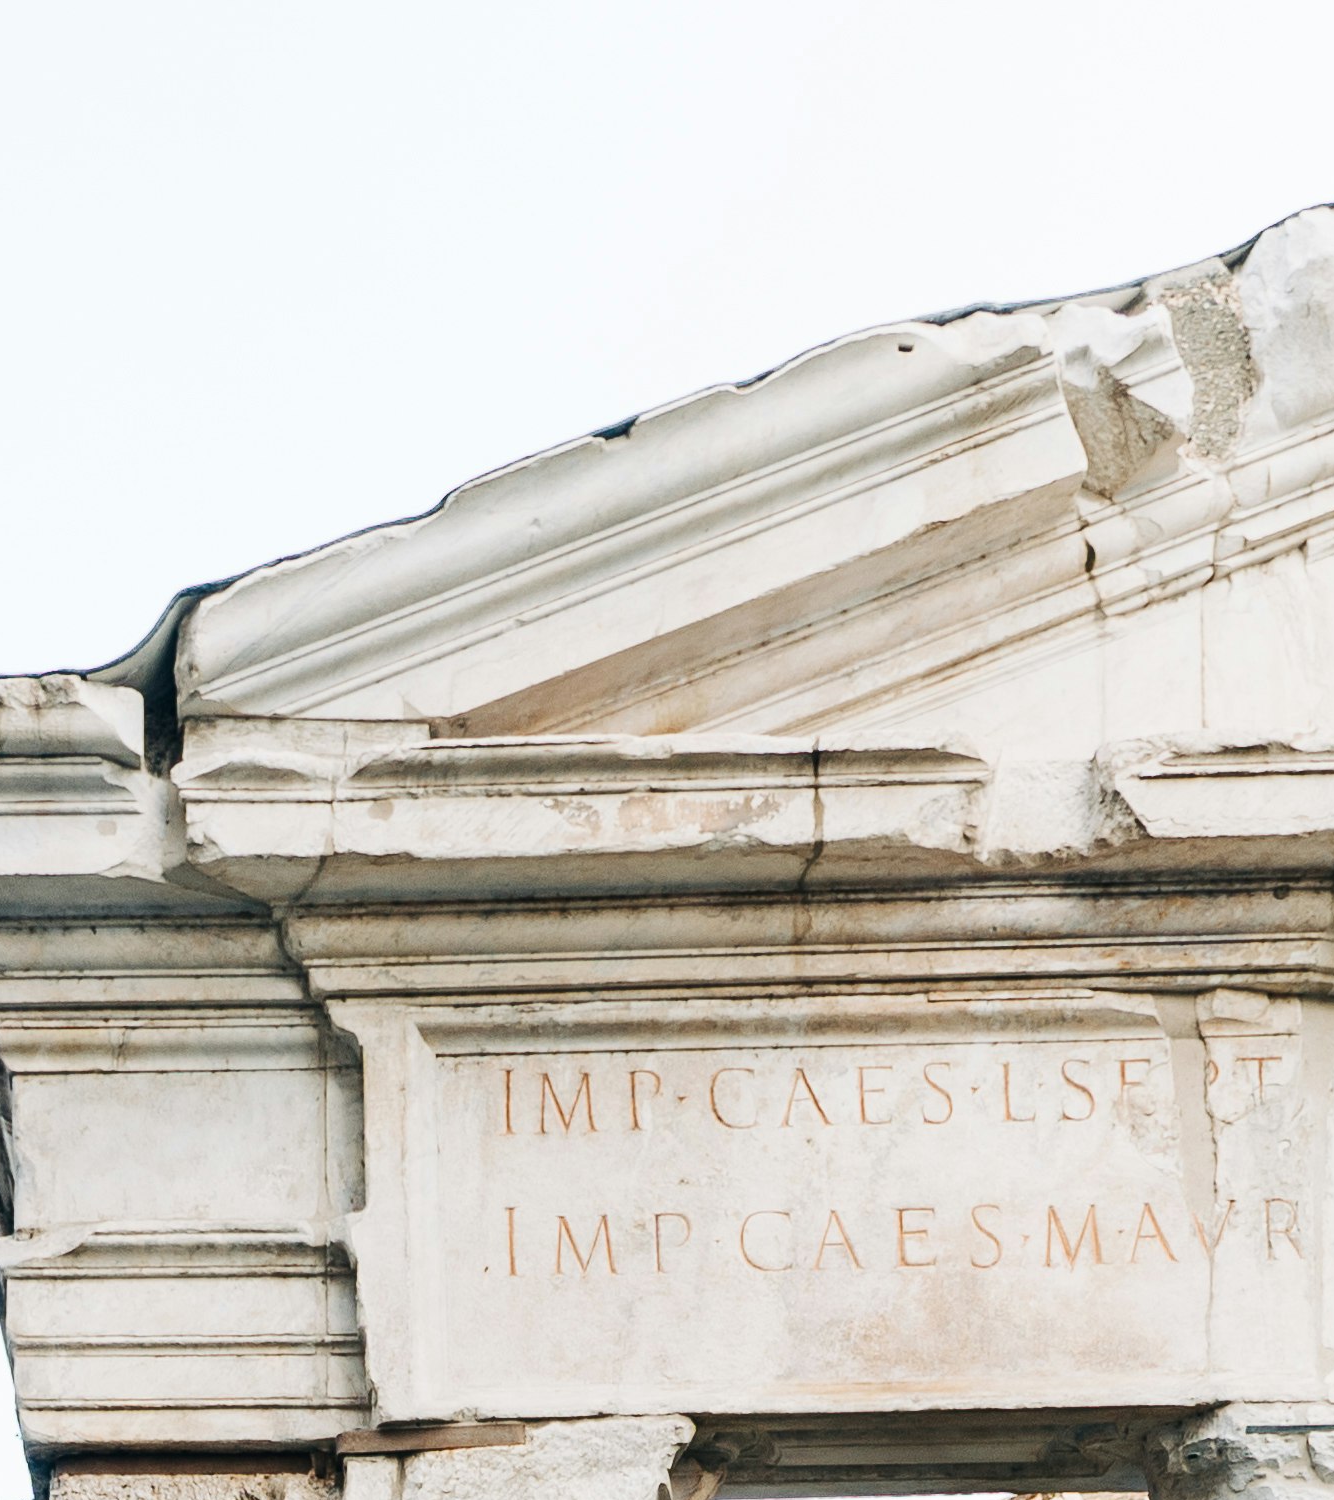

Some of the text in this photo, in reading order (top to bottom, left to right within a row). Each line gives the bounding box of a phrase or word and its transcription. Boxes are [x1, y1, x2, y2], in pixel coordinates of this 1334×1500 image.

[498, 1067, 663, 1136] IMP
[709, 1061, 954, 1129] CAES
[1002, 1062, 1037, 1122] L
[504, 1207, 692, 1276] IMP
[739, 1204, 1003, 1272] CAES
[1044, 1204, 1111, 1271] M
